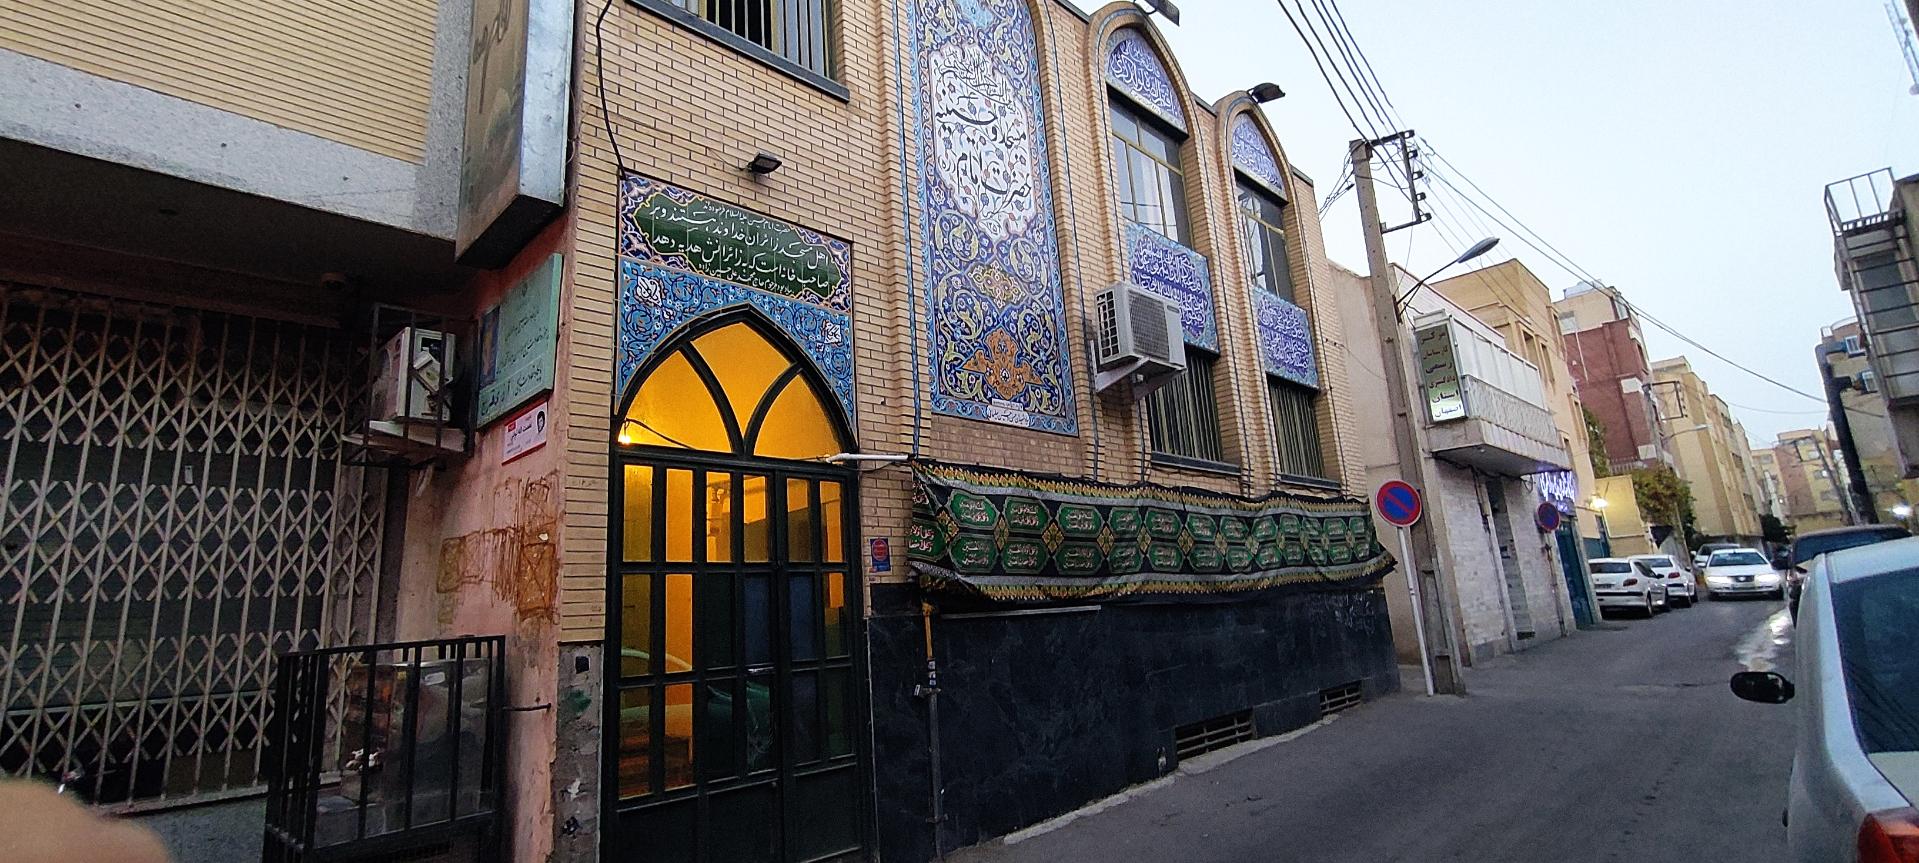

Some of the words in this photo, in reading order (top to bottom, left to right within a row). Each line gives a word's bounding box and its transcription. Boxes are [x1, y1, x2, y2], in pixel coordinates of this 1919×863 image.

[747, 217, 767, 228] حسین
[774, 223, 791, 234] حضرت
[711, 222, 746, 240] خداوند
[653, 235, 676, 248] دهد
[678, 243, 702, 253] هدیه
[745, 232, 779, 251] زائران
[702, 237, 743, 266] زائرانش
[777, 242, 813, 264] مسجد
[748, 252, 766, 269] که
[807, 250, 828, 269] اهل
[755, 261, 782, 275] است
[781, 265, 796, 281] خانه
[796, 275, 829, 288] صاحب
[1421, 331, 1447, 344] مرکز
[1425, 362, 1453, 374] رسمی
[1432, 389, 1459, 403] استان
